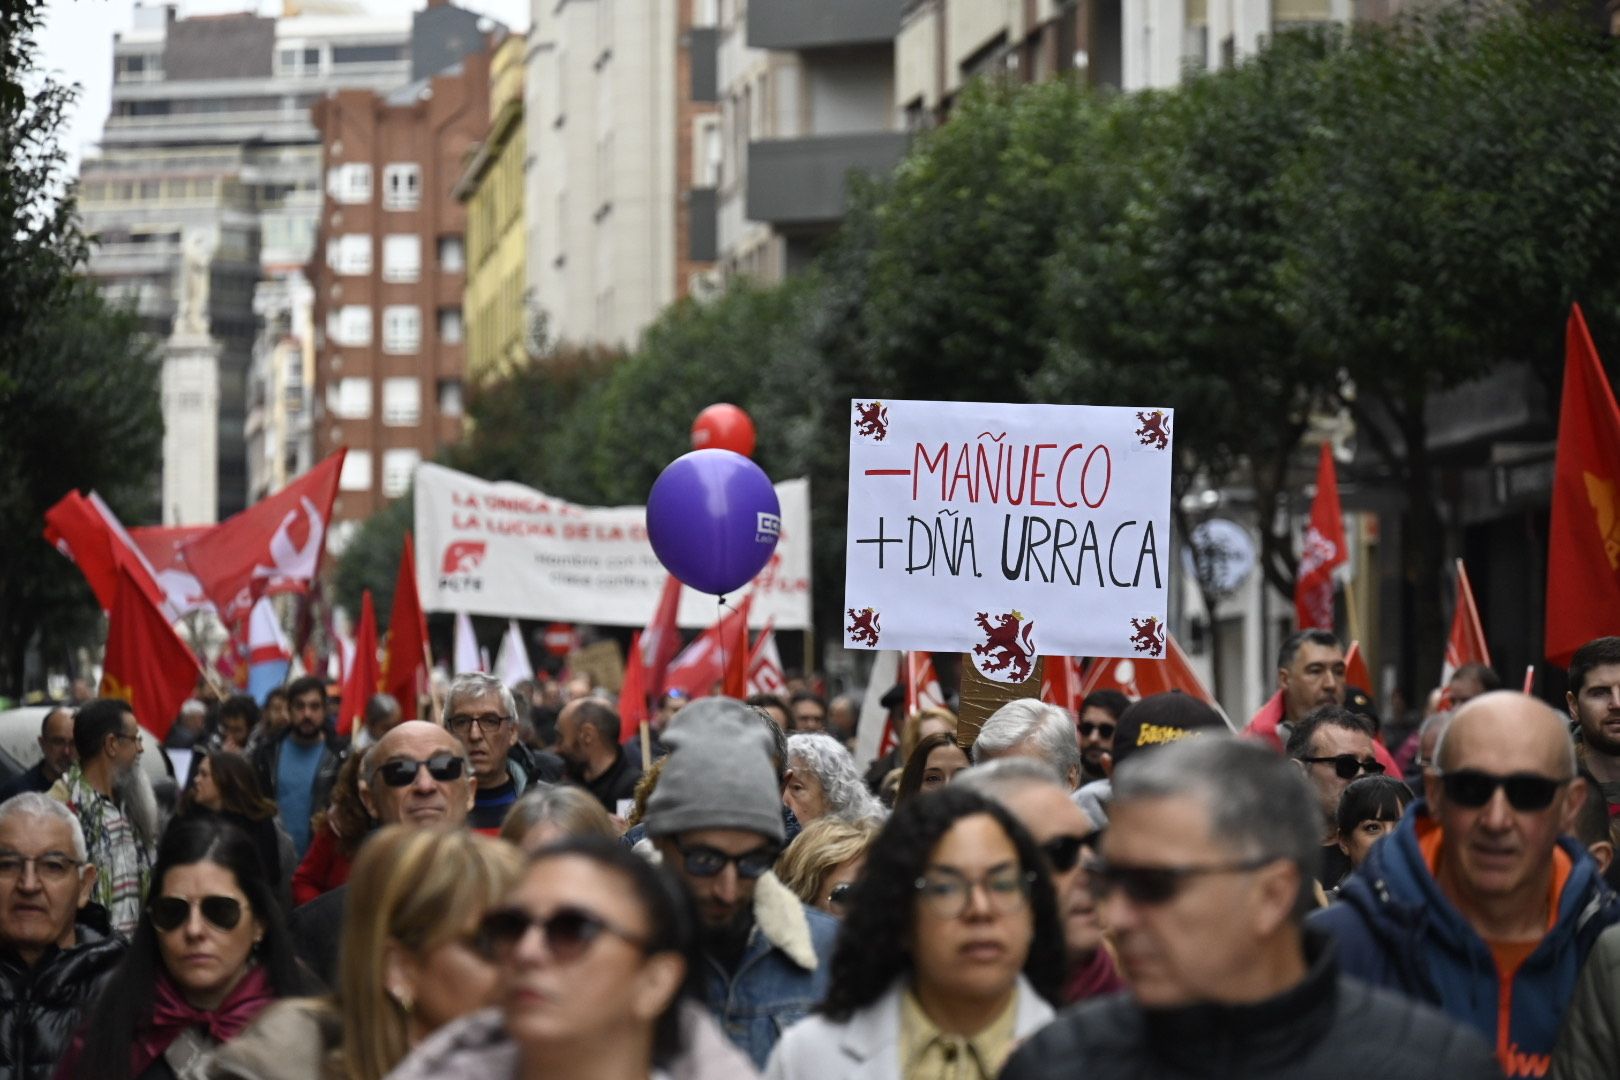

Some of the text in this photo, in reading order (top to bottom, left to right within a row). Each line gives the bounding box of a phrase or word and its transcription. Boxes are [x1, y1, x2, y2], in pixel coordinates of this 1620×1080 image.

[451, 513, 480, 530] LA
[486, 518, 556, 539] LUCHA
[562, 522, 591, 541] DE
[595, 524, 625, 541] LA
[1001, 514, 1161, 588] URRACA
